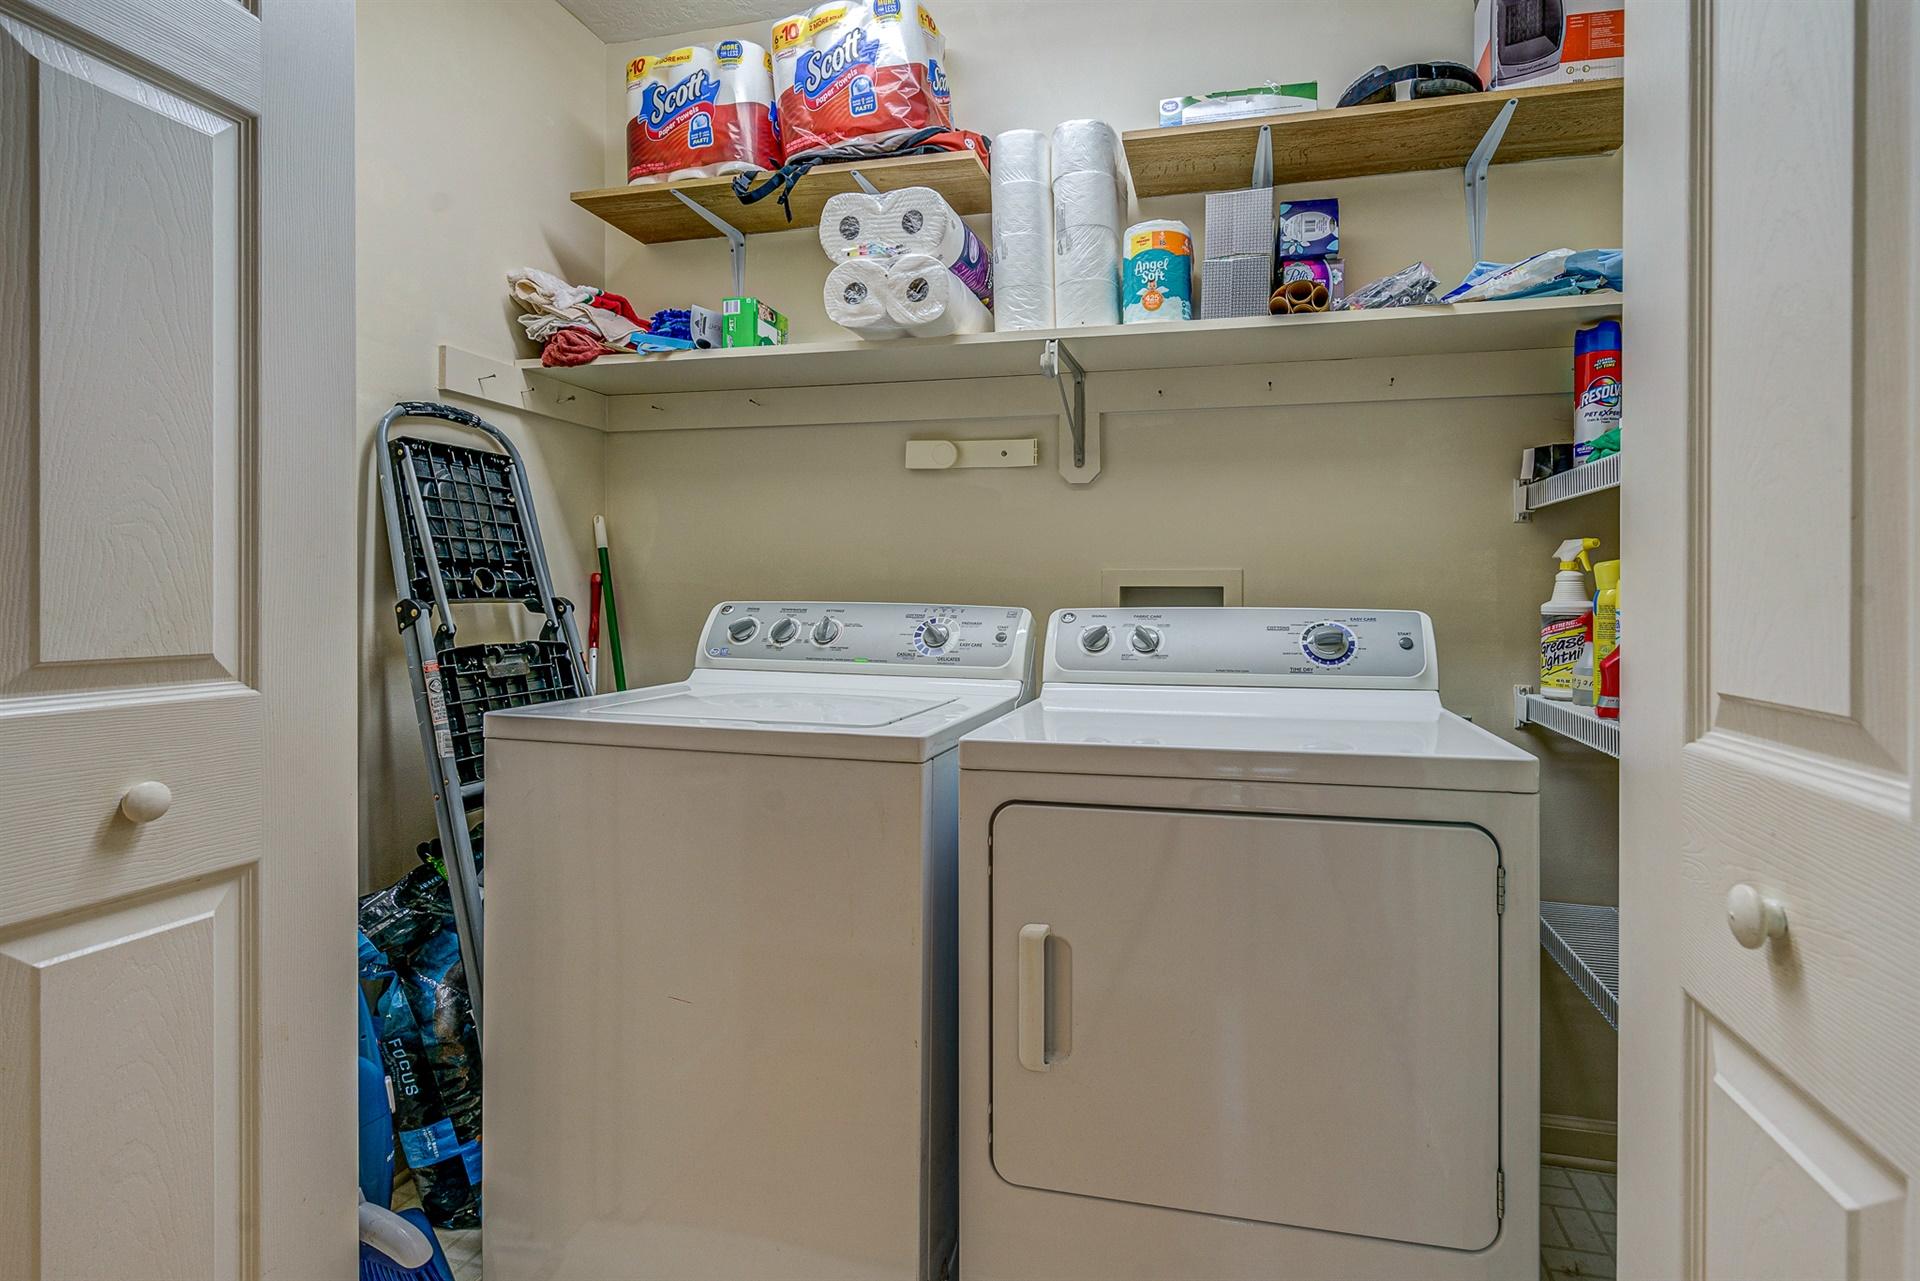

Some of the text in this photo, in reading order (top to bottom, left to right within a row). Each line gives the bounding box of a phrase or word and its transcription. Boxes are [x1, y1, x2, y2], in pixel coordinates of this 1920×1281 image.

[885, 4, 897, 13] LESS
[813, 16, 829, 30] MORE
[805, 27, 862, 93] Scott
[651, 69, 705, 123] Scott
[815, 69, 859, 107] Paper Towels
[658, 106, 700, 138] Paper Towels
[1134, 258, 1169, 276] Angel
[1141, 269, 1166, 284] Soft
[1580, 382, 1622, 408] RESOLV
[1541, 634, 1585, 657] Grease
[387, 1037, 419, 1097] FOCUS
